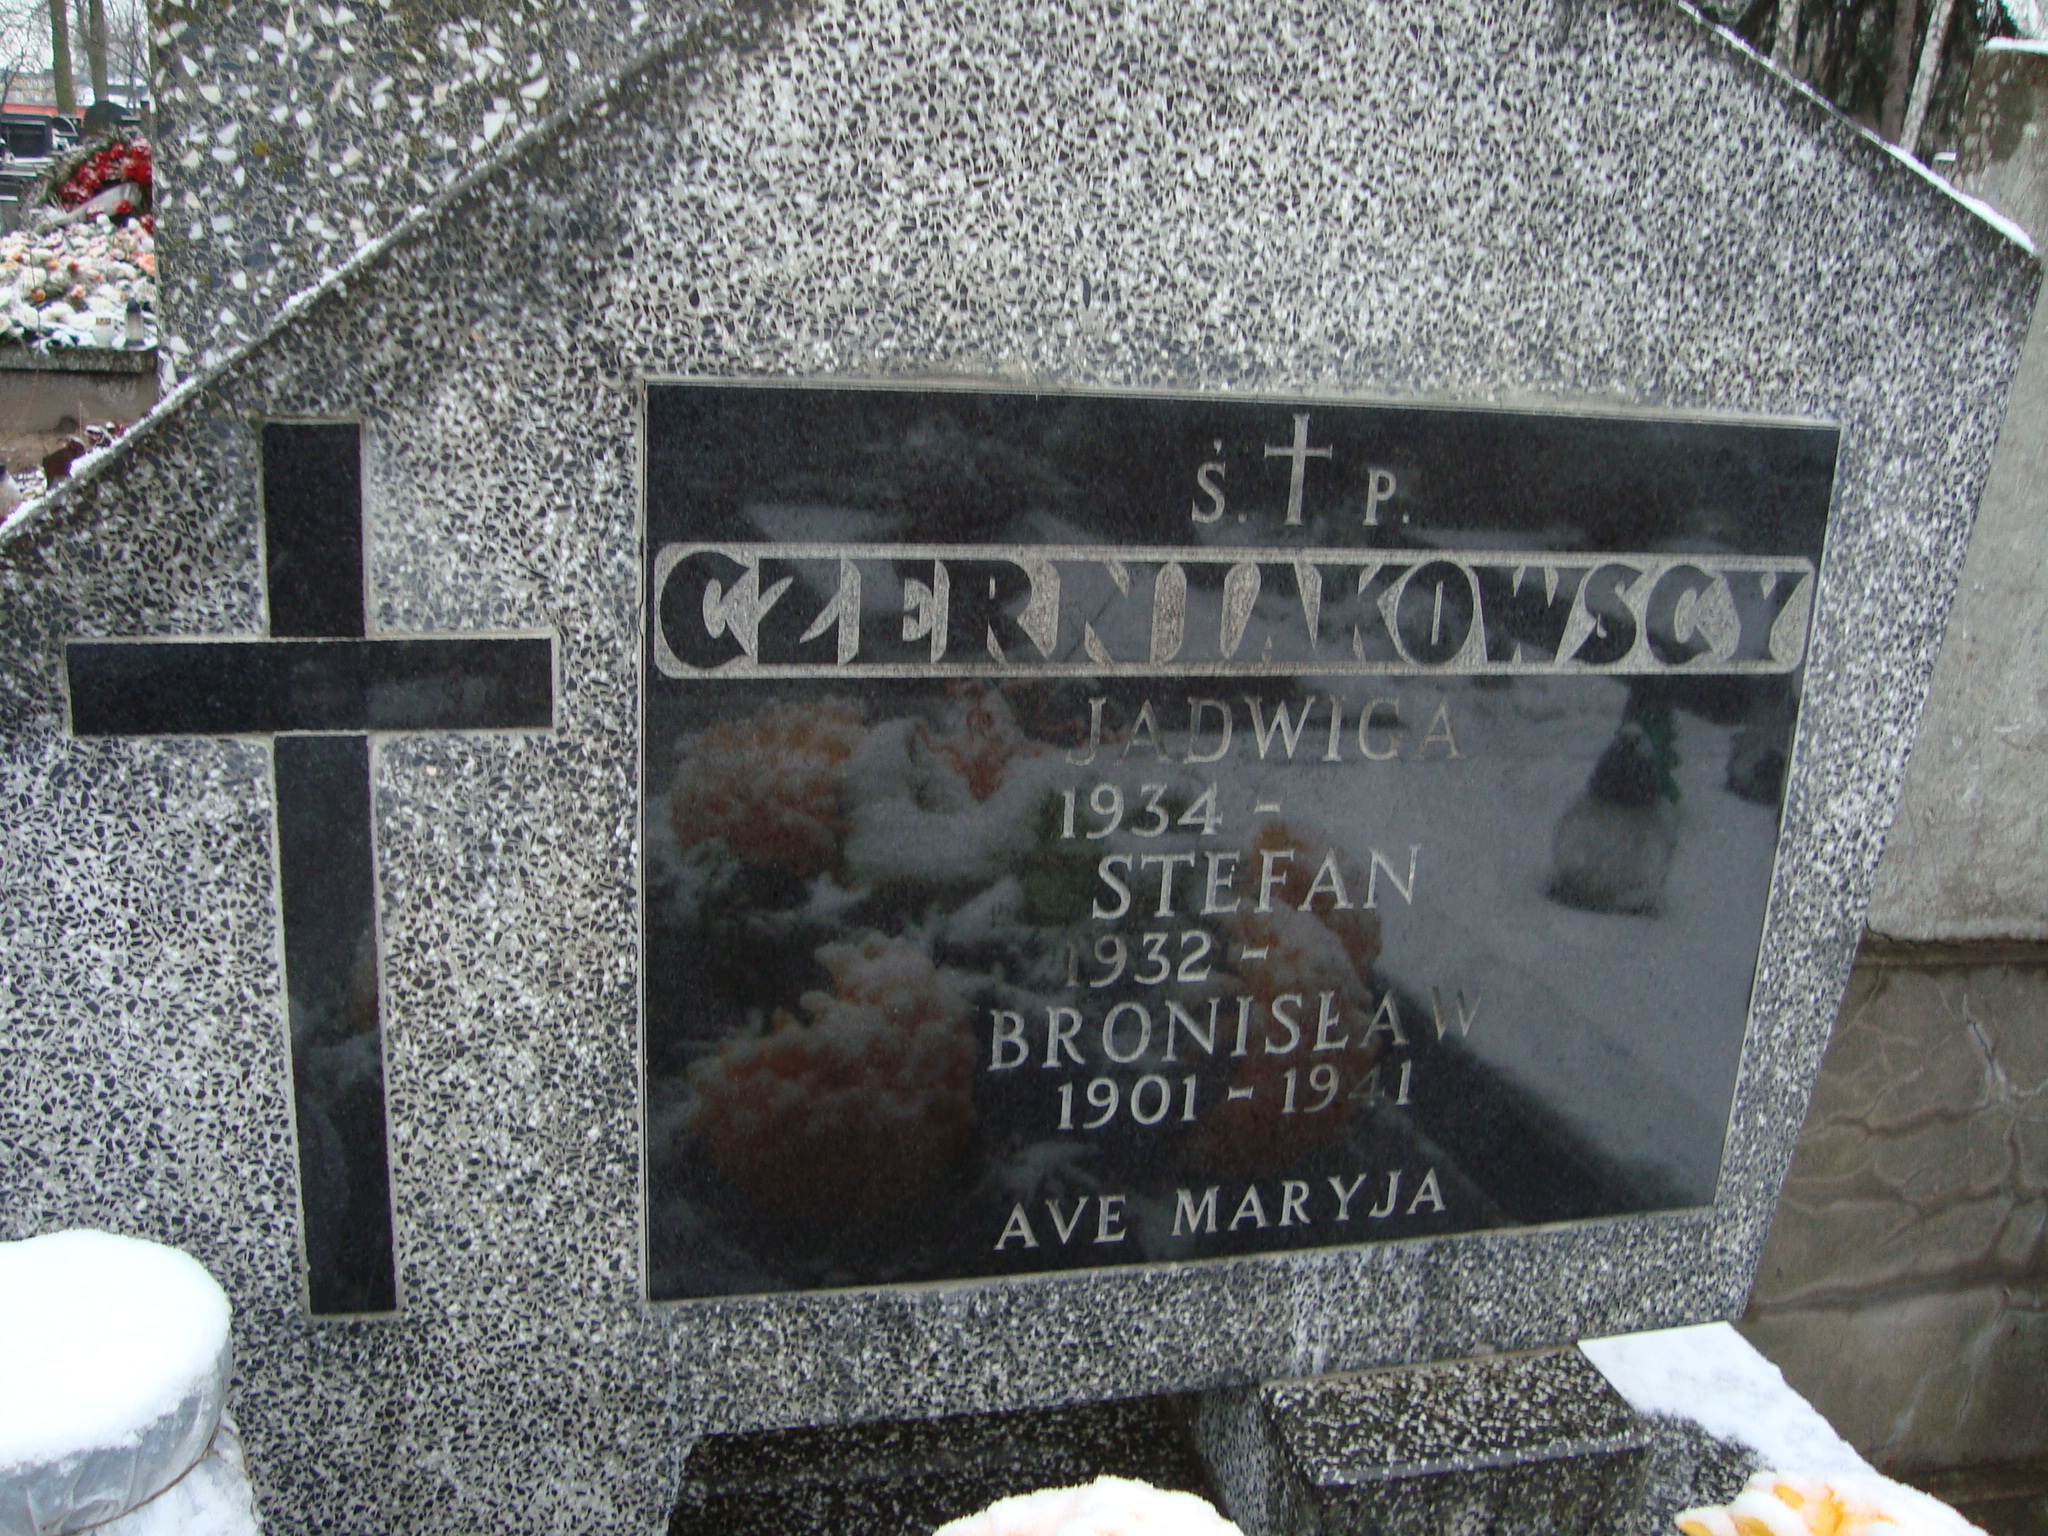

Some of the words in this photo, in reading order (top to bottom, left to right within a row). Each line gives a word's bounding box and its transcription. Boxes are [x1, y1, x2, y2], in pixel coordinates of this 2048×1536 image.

[1362, 466, 1410, 526] P.
[1066, 695, 1468, 766] JADWIGA
[1060, 782, 1224, 840] 1934
[1092, 844, 1421, 920] STEFAN
[1066, 929, 1212, 988] 1932
[987, 984, 1484, 1072] BRONISŁAW
[1056, 1074, 1197, 1131] 1901
[1280, 1058, 1412, 1115] 1941
[993, 1195, 1127, 1251] AVE
[1170, 1167, 1447, 1238] MARYJA
